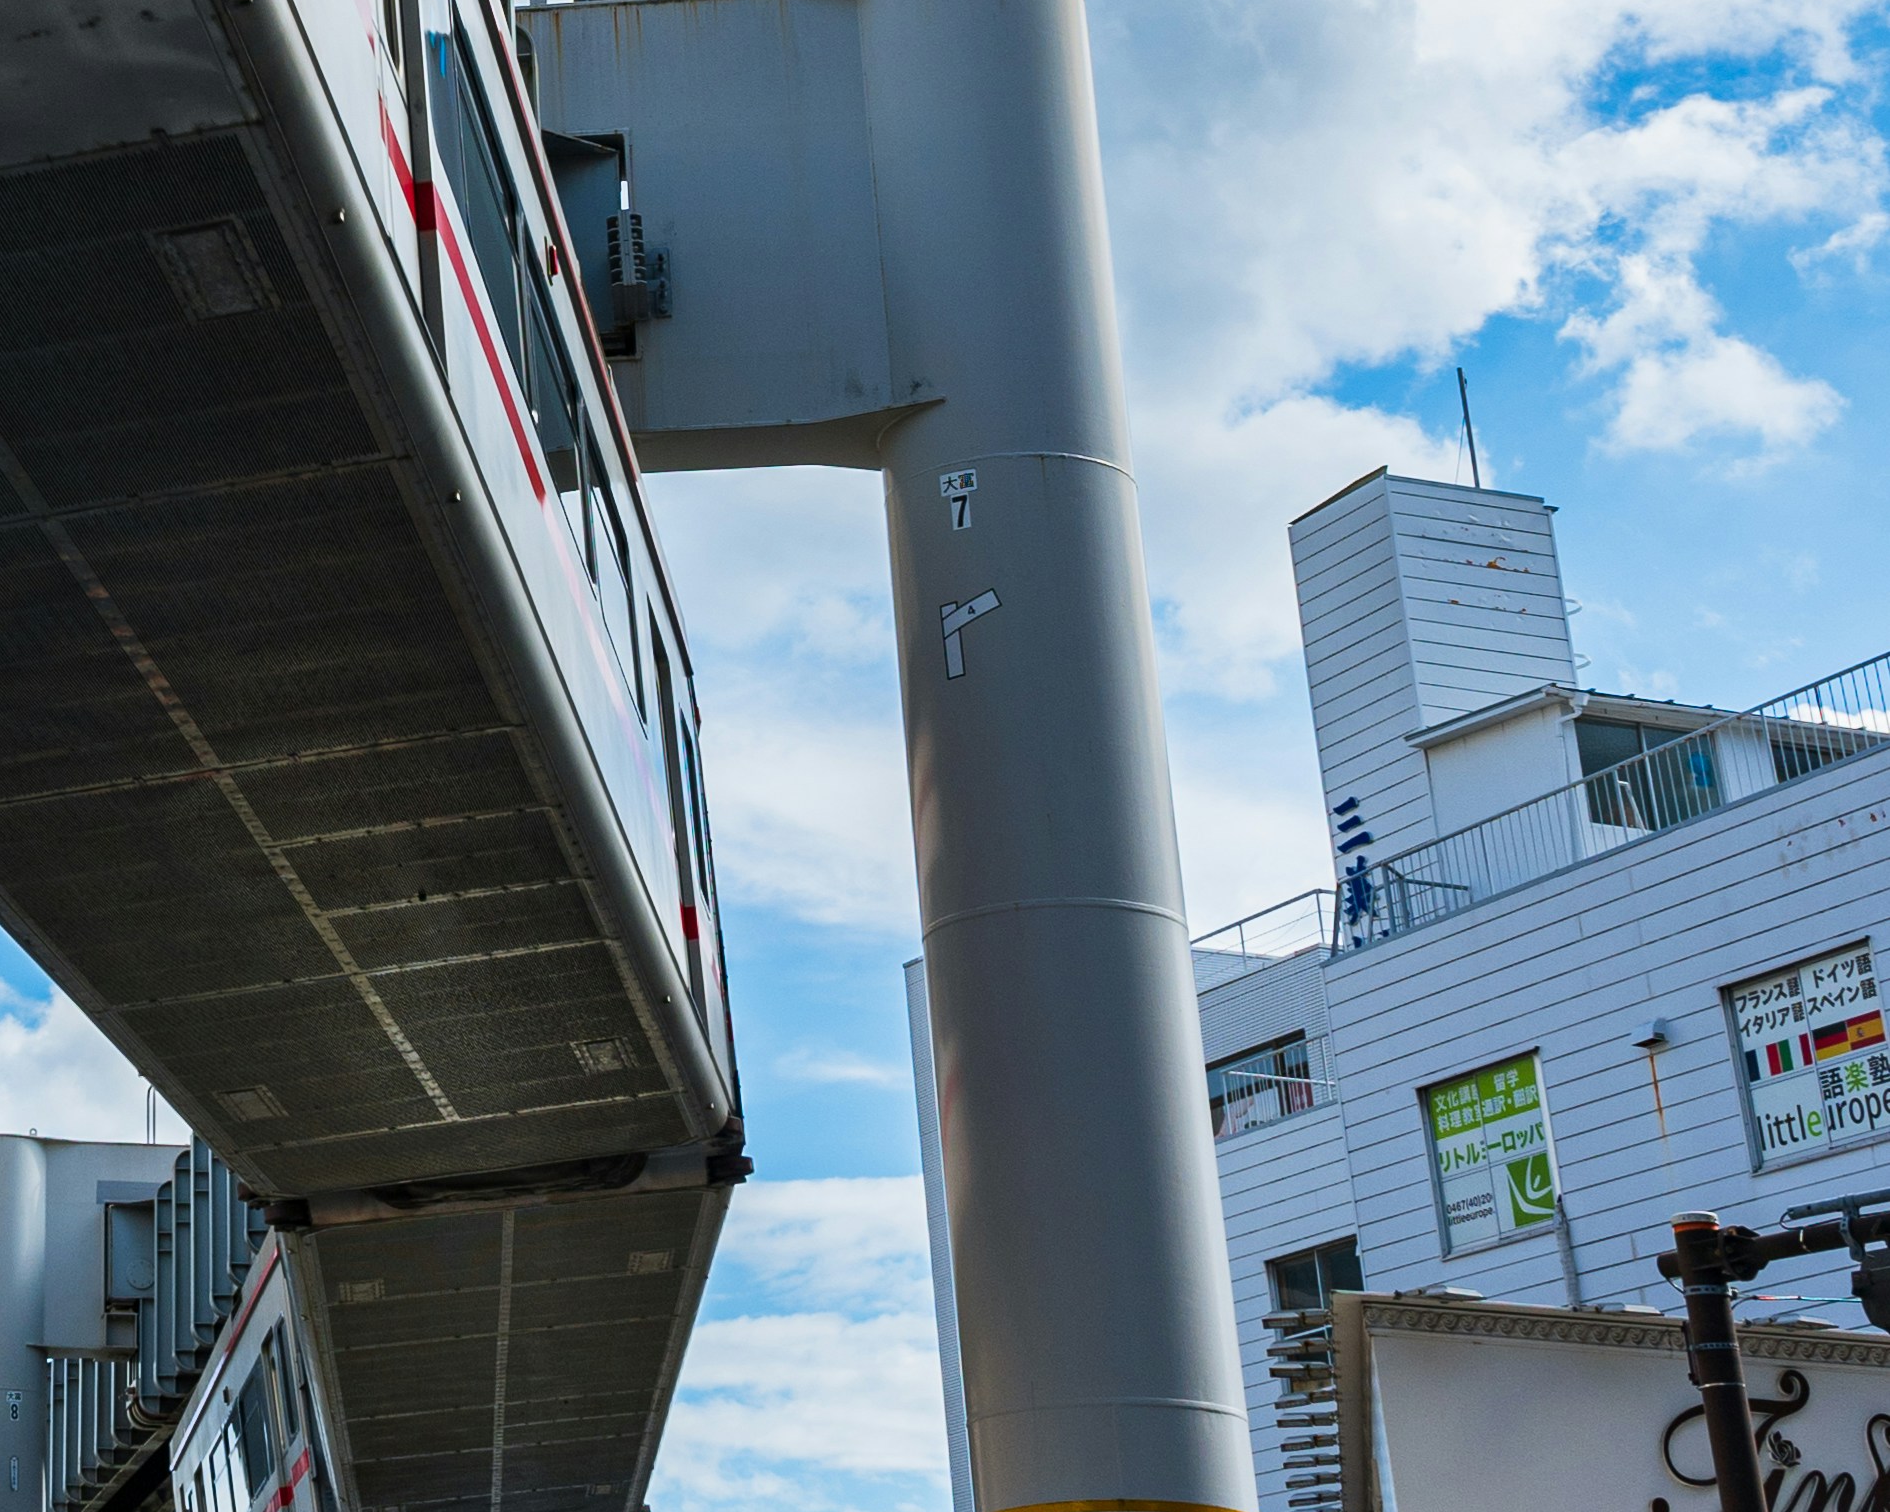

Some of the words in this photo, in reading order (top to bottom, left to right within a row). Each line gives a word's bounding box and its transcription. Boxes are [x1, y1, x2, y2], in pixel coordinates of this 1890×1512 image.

[951, 494, 968, 528] 7
[967, 605, 977, 615] 4
[1812, 952, 1873, 989] ドイツ語
[1807, 977, 1878, 1016] スペイン語
[1819, 1053, 1890, 1100] 語楽塾
[10, 1403, 19, 1420] 8
